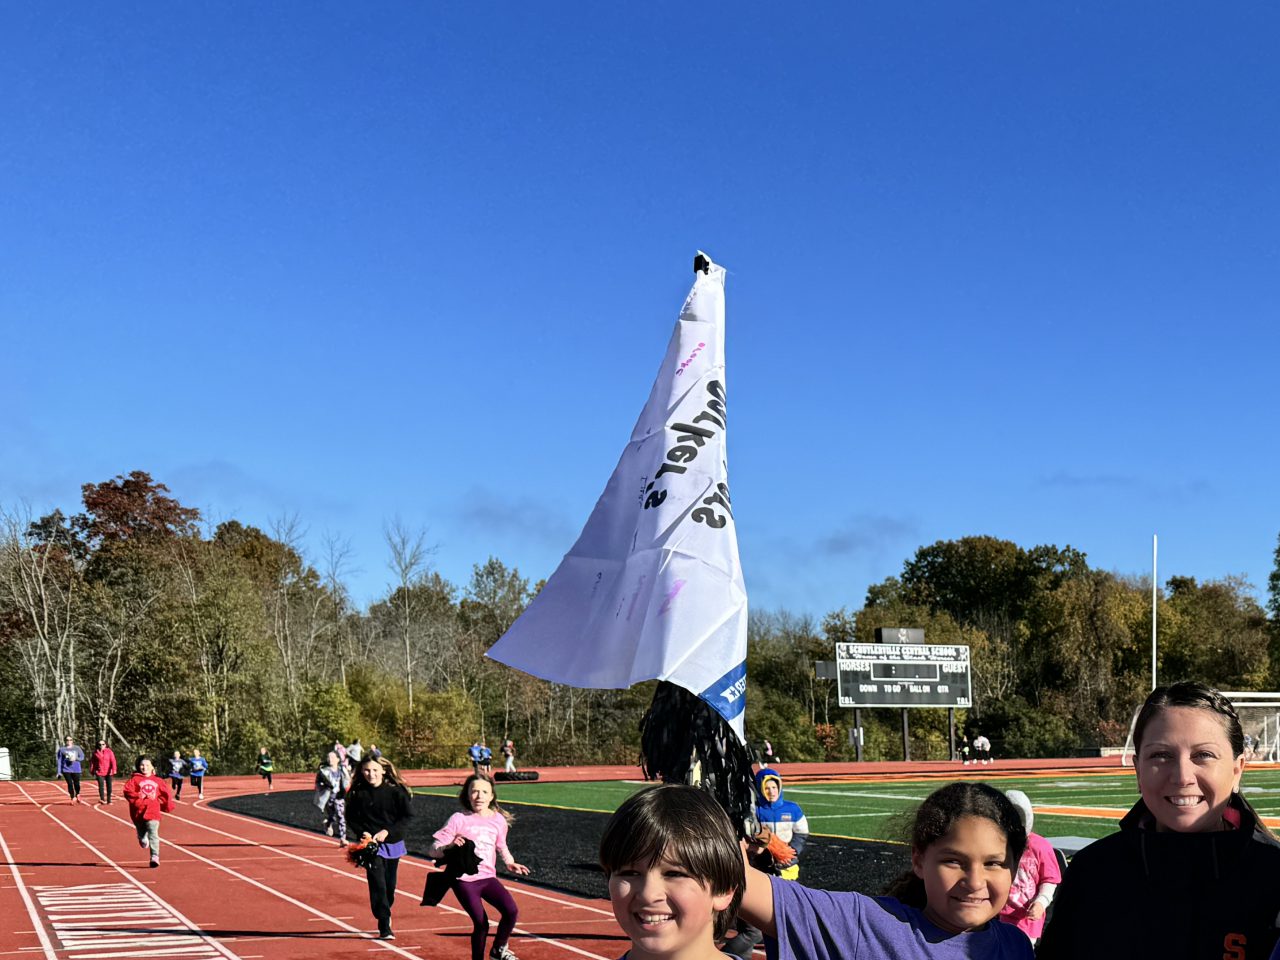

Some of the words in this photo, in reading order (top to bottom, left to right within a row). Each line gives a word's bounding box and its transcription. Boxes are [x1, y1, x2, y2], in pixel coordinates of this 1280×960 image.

[931, 648, 956, 656] SCHOOL
[840, 662, 870, 672] HORSES
[942, 664, 966, 672] GUEST
[860, 684, 878, 692] DOWN
[884, 684, 892, 692] TO
[893, 684, 902, 692] GO
